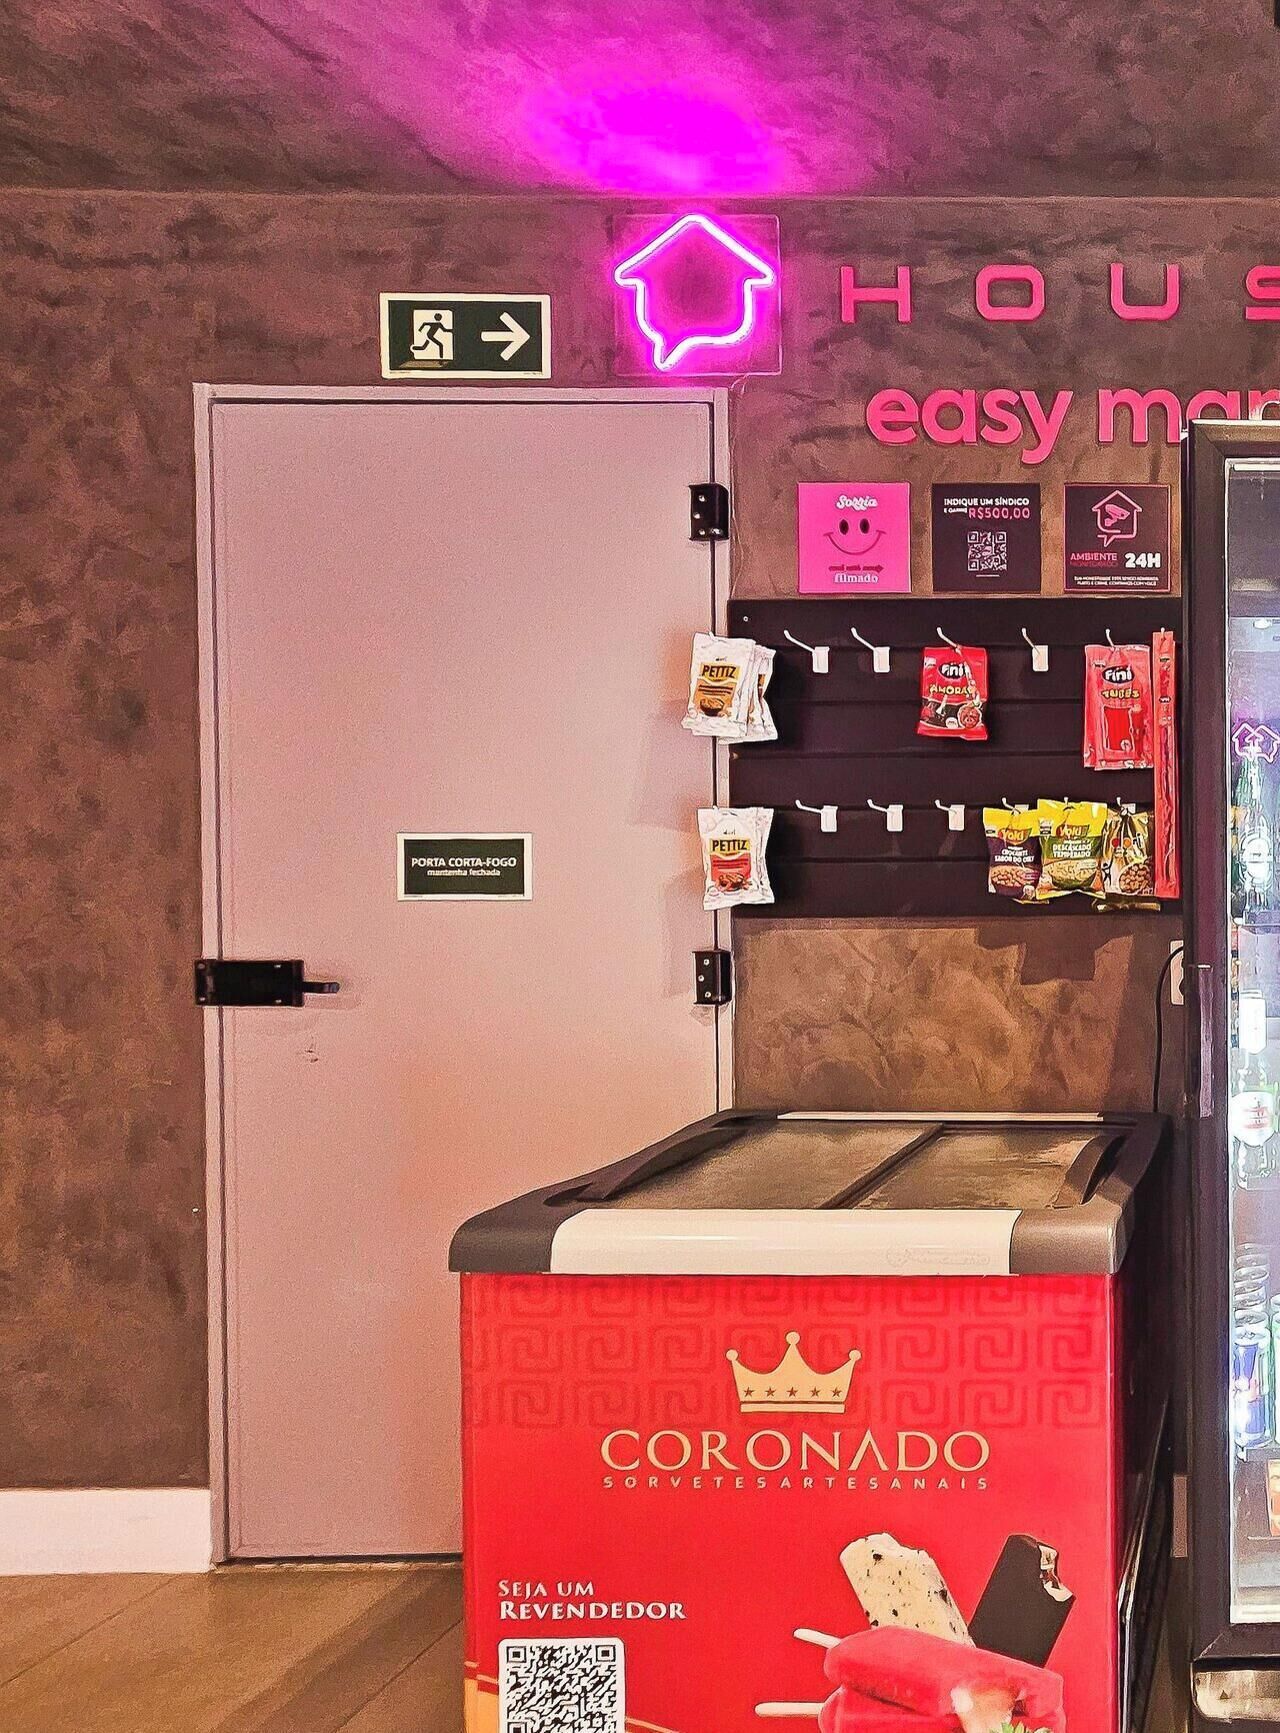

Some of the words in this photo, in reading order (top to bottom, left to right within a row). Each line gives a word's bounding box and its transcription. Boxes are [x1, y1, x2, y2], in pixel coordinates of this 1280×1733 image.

[866, 386, 1074, 465] easy
[943, 498, 979, 507] INDIQUE
[979, 498, 993, 506] UM
[994, 496, 1030, 506] SÍNDICO
[968, 507, 1030, 519] R$500,00
[1070, 552, 1118, 561] AMBIENTE
[1124, 552, 1161, 568] 24H
[834, 573, 879, 583] filmado
[702, 664, 737, 678] PETTIZ
[712, 839, 748, 852] PETTIZ
[411, 857, 446, 868] PORTA
[448, 857, 517, 868] CORTA-FOGO
[600, 1428, 991, 1473] CORONADO
